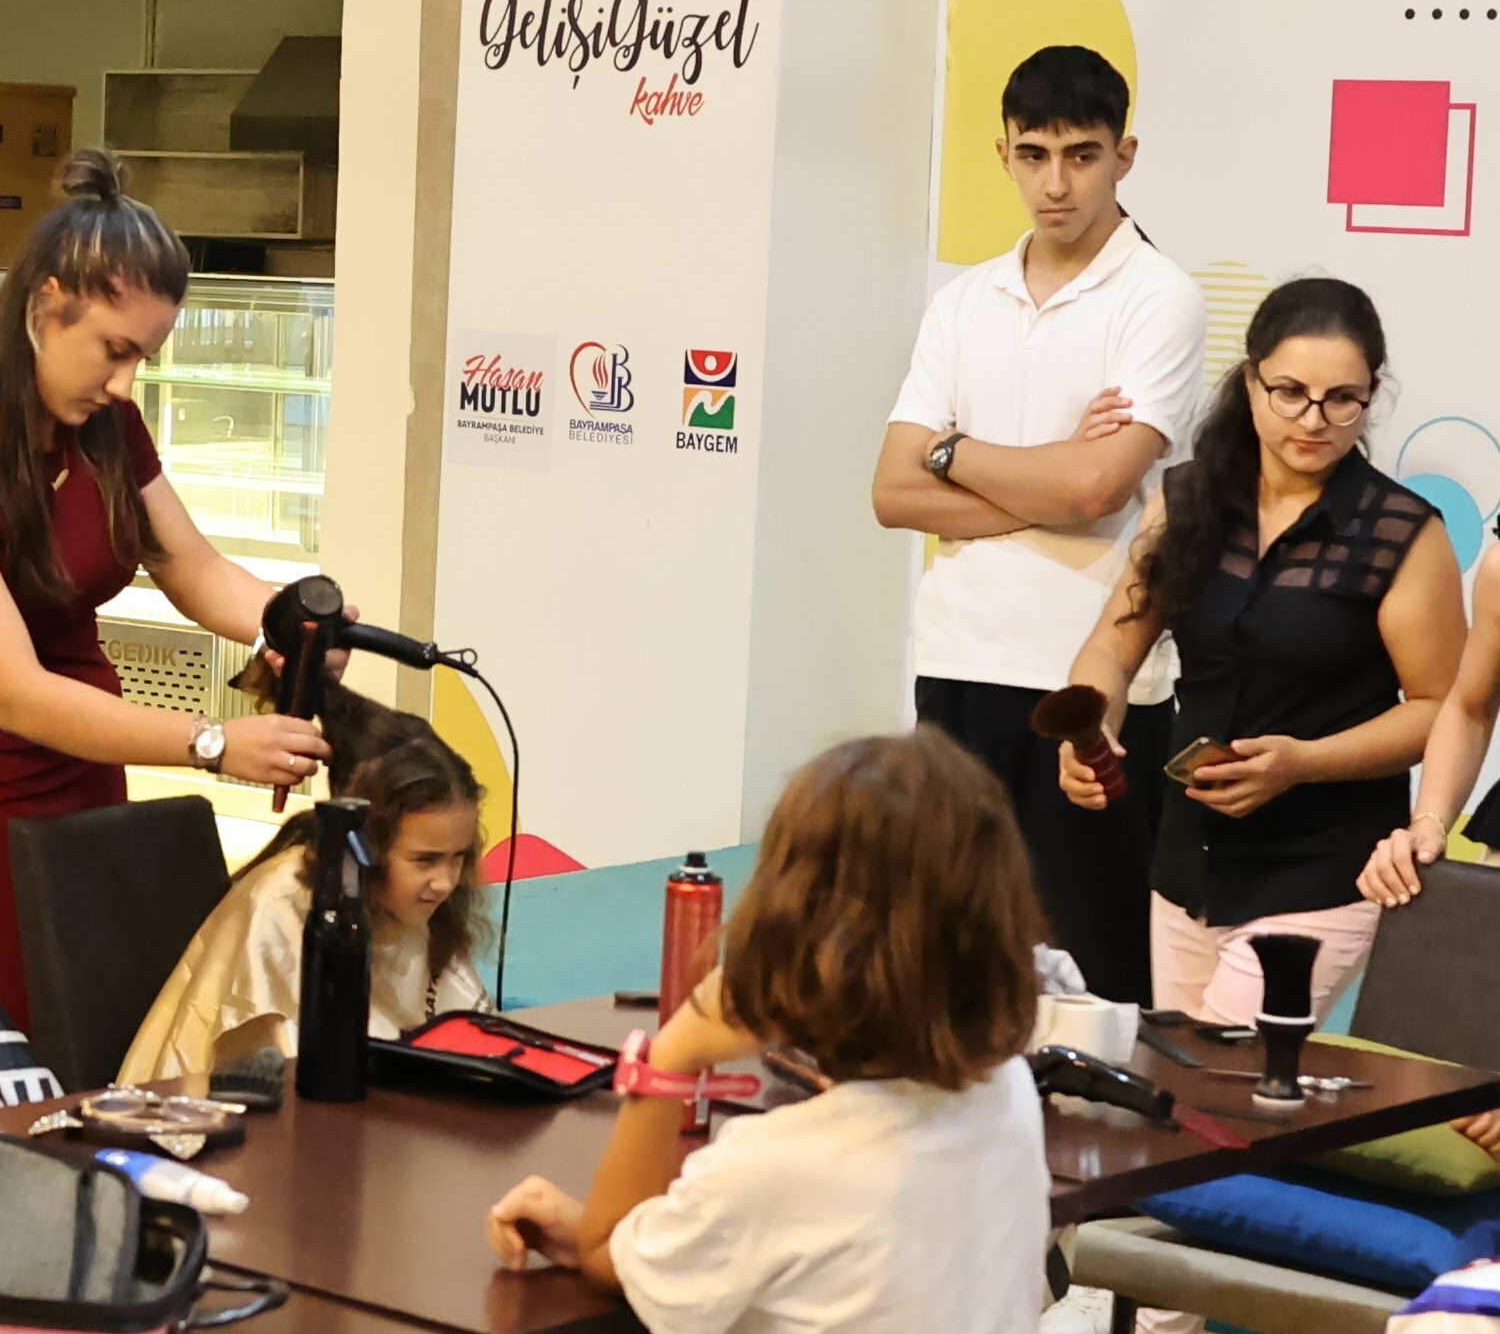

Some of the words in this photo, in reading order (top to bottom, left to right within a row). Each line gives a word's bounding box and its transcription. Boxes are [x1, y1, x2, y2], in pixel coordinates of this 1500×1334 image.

[629, 74, 704, 125] kahve
[463, 354, 544, 392] Hasan
[459, 381, 541, 417] MUTLU
[569, 419, 633, 434] BAYRAMPAŞA
[675, 430, 738, 454] BAYGEM
